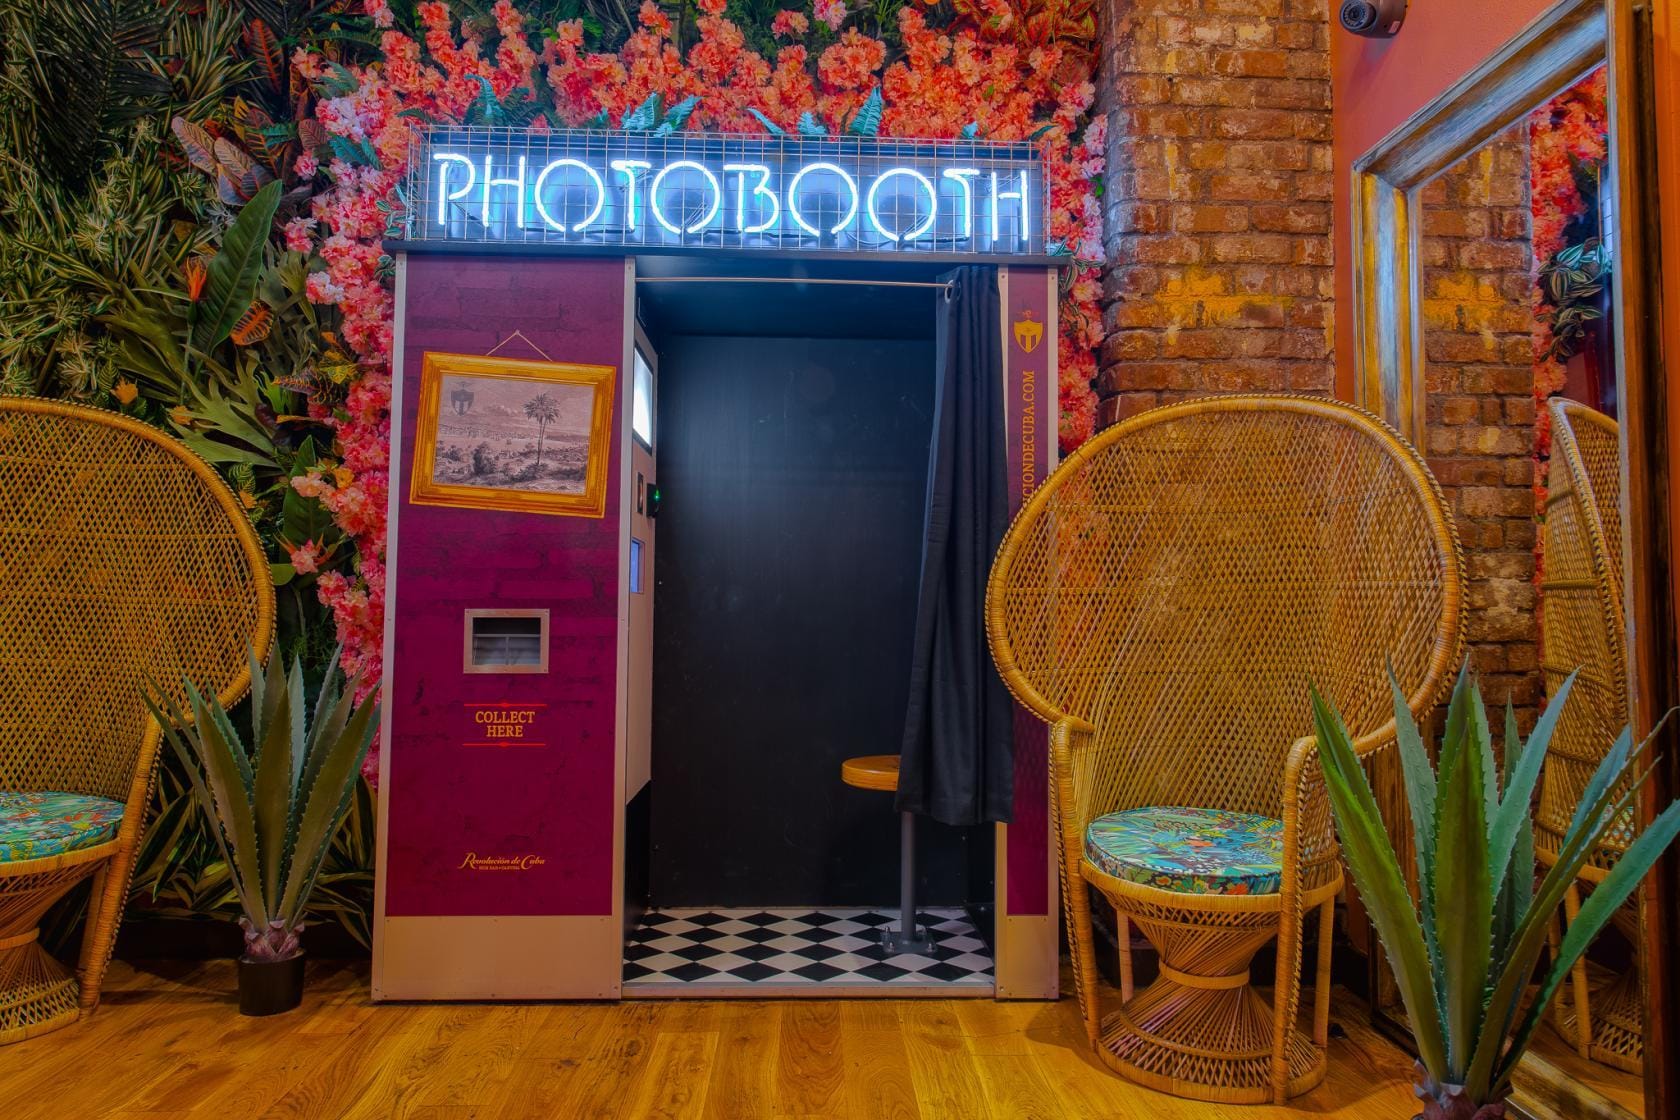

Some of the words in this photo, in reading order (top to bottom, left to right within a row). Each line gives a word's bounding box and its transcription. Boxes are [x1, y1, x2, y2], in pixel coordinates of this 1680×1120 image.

[433, 152, 1029, 242] PHOTOBOOTH
[1022, 370, 1035, 502] CIONDECUBA.COM
[475, 711, 535, 723] COLLECT
[486, 725, 523, 737] HERE
[510, 856, 521, 865] de
[520, 854, 545, 870] Cuba
